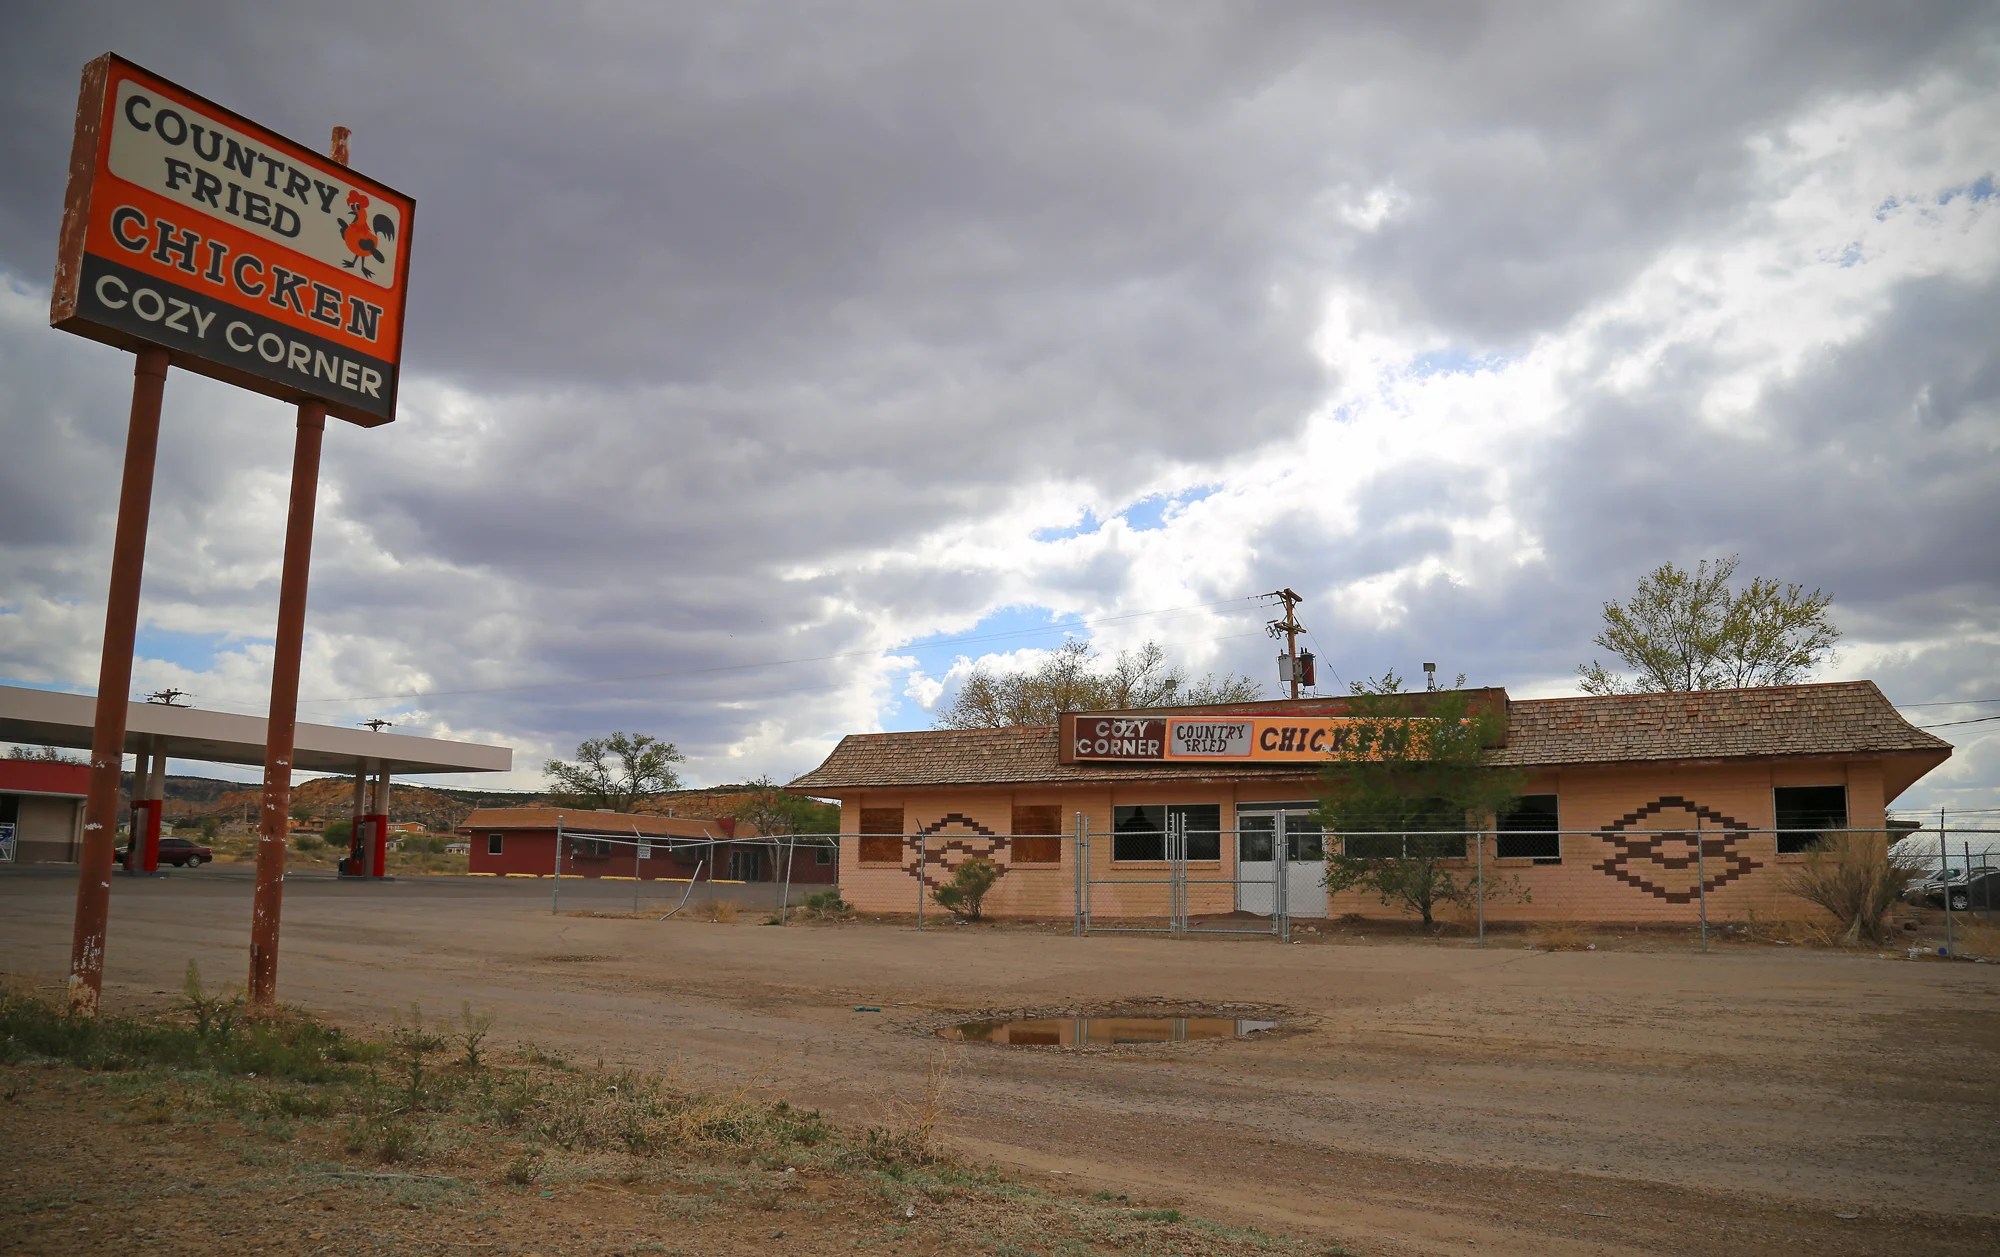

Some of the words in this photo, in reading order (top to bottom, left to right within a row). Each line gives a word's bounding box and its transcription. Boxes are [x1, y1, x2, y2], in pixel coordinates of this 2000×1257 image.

[125, 95, 339, 214] COUNTRY
[164, 157, 301, 238] FRIED
[111, 206, 384, 344] CHICKEN
[95, 275, 217, 339] COZY
[225, 320, 383, 399] CORNER
[1078, 738, 1160, 756] CORNER
[1095, 720, 1150, 738] COZY
[1176, 725, 1245, 741] COUNTRY
[1184, 738, 1227, 753] FRIED
